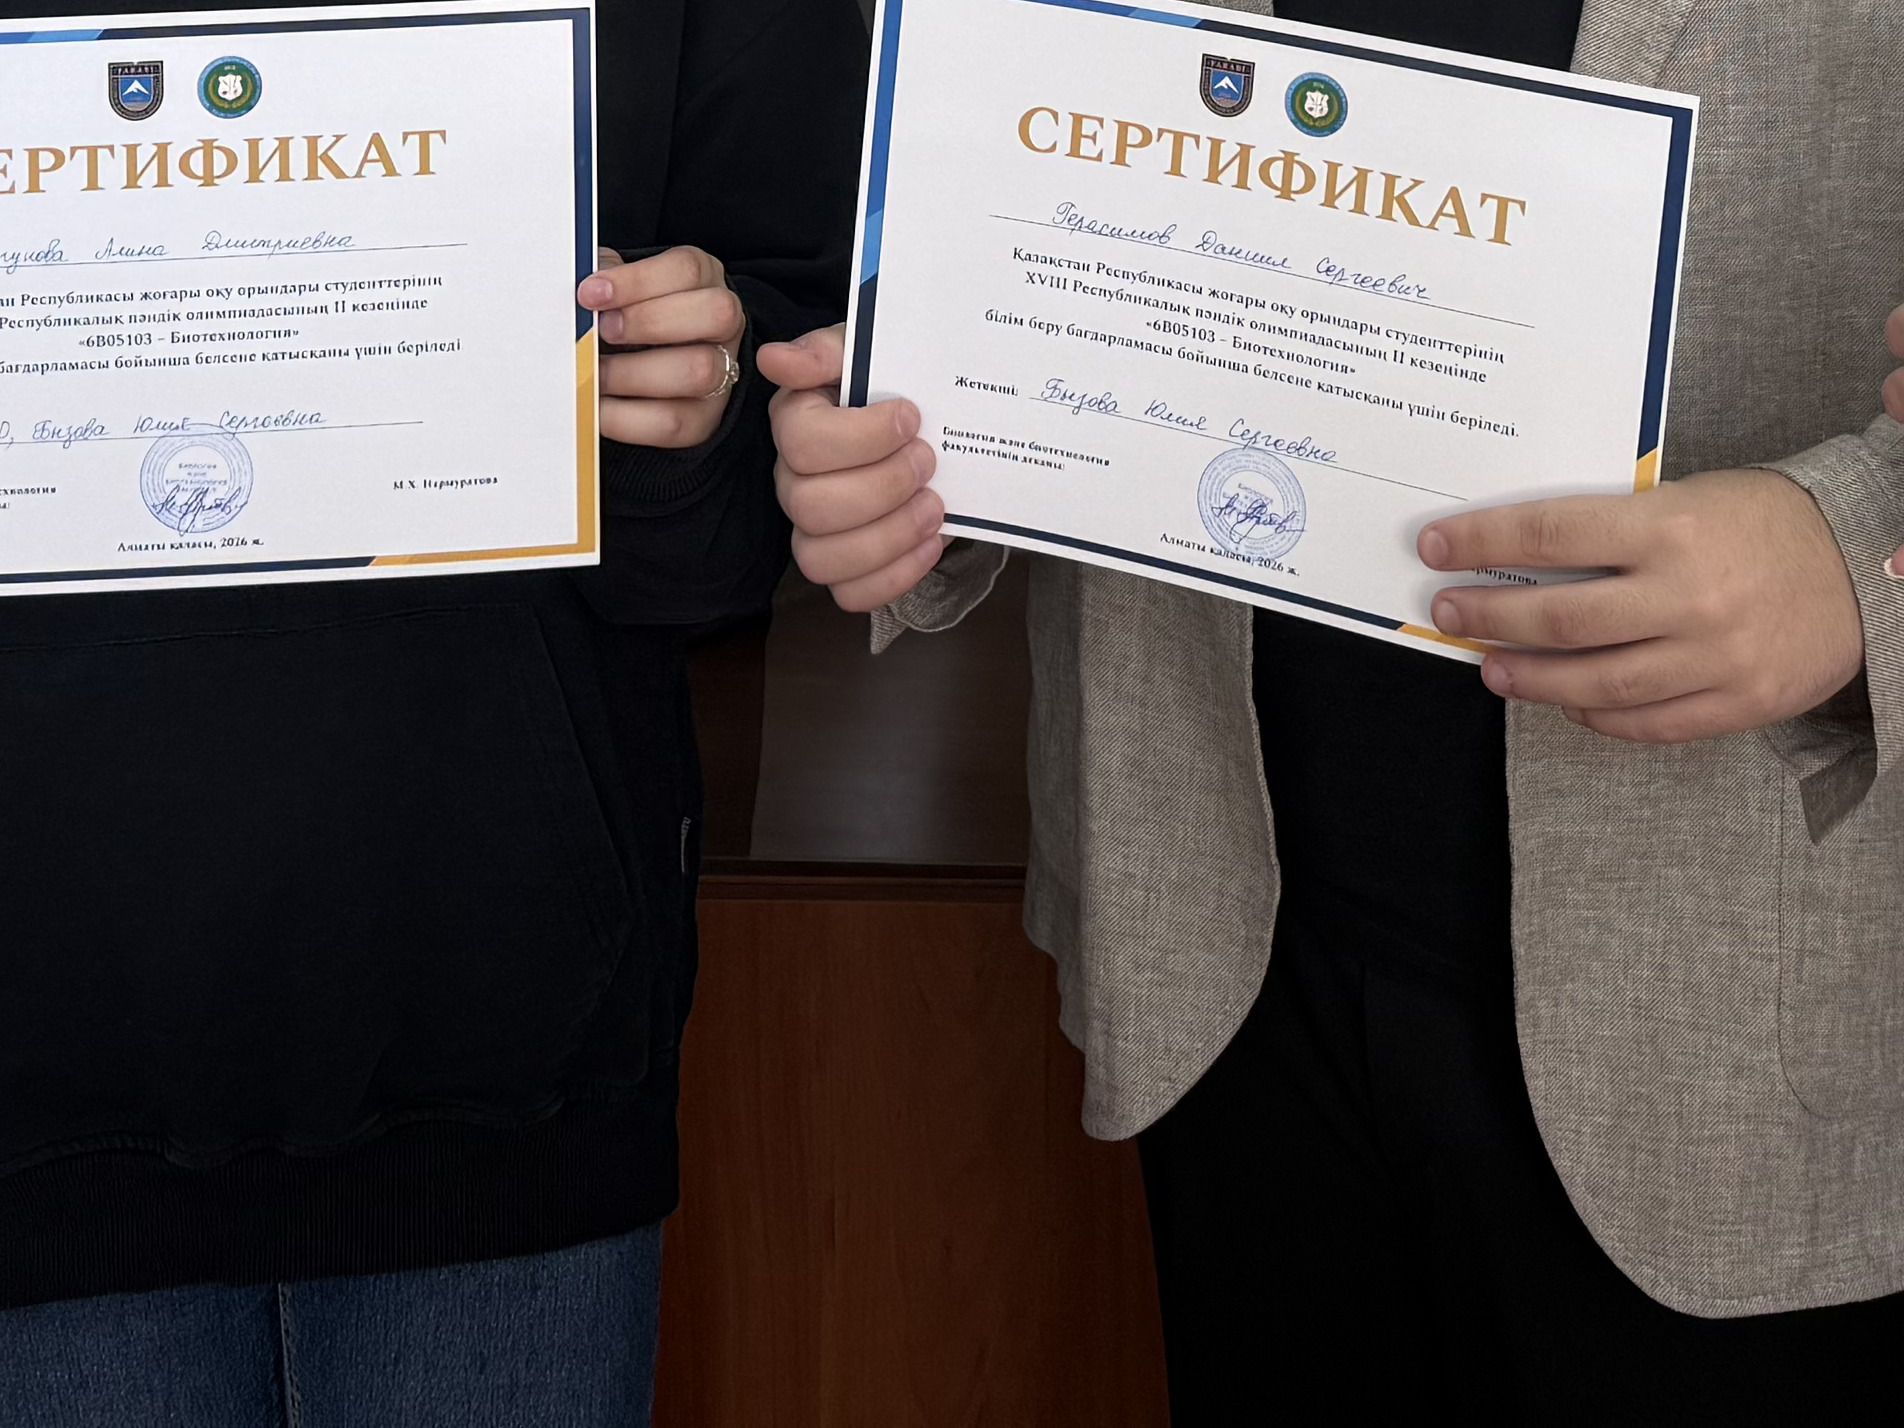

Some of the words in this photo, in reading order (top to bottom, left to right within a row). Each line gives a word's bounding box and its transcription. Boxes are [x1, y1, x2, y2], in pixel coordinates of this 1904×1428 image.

[1017, 106, 1527, 247] СЕРТИФИКАТ
[1025, 271, 1068, 291] XVIII
[1096, 261, 1203, 295] Республикасы
